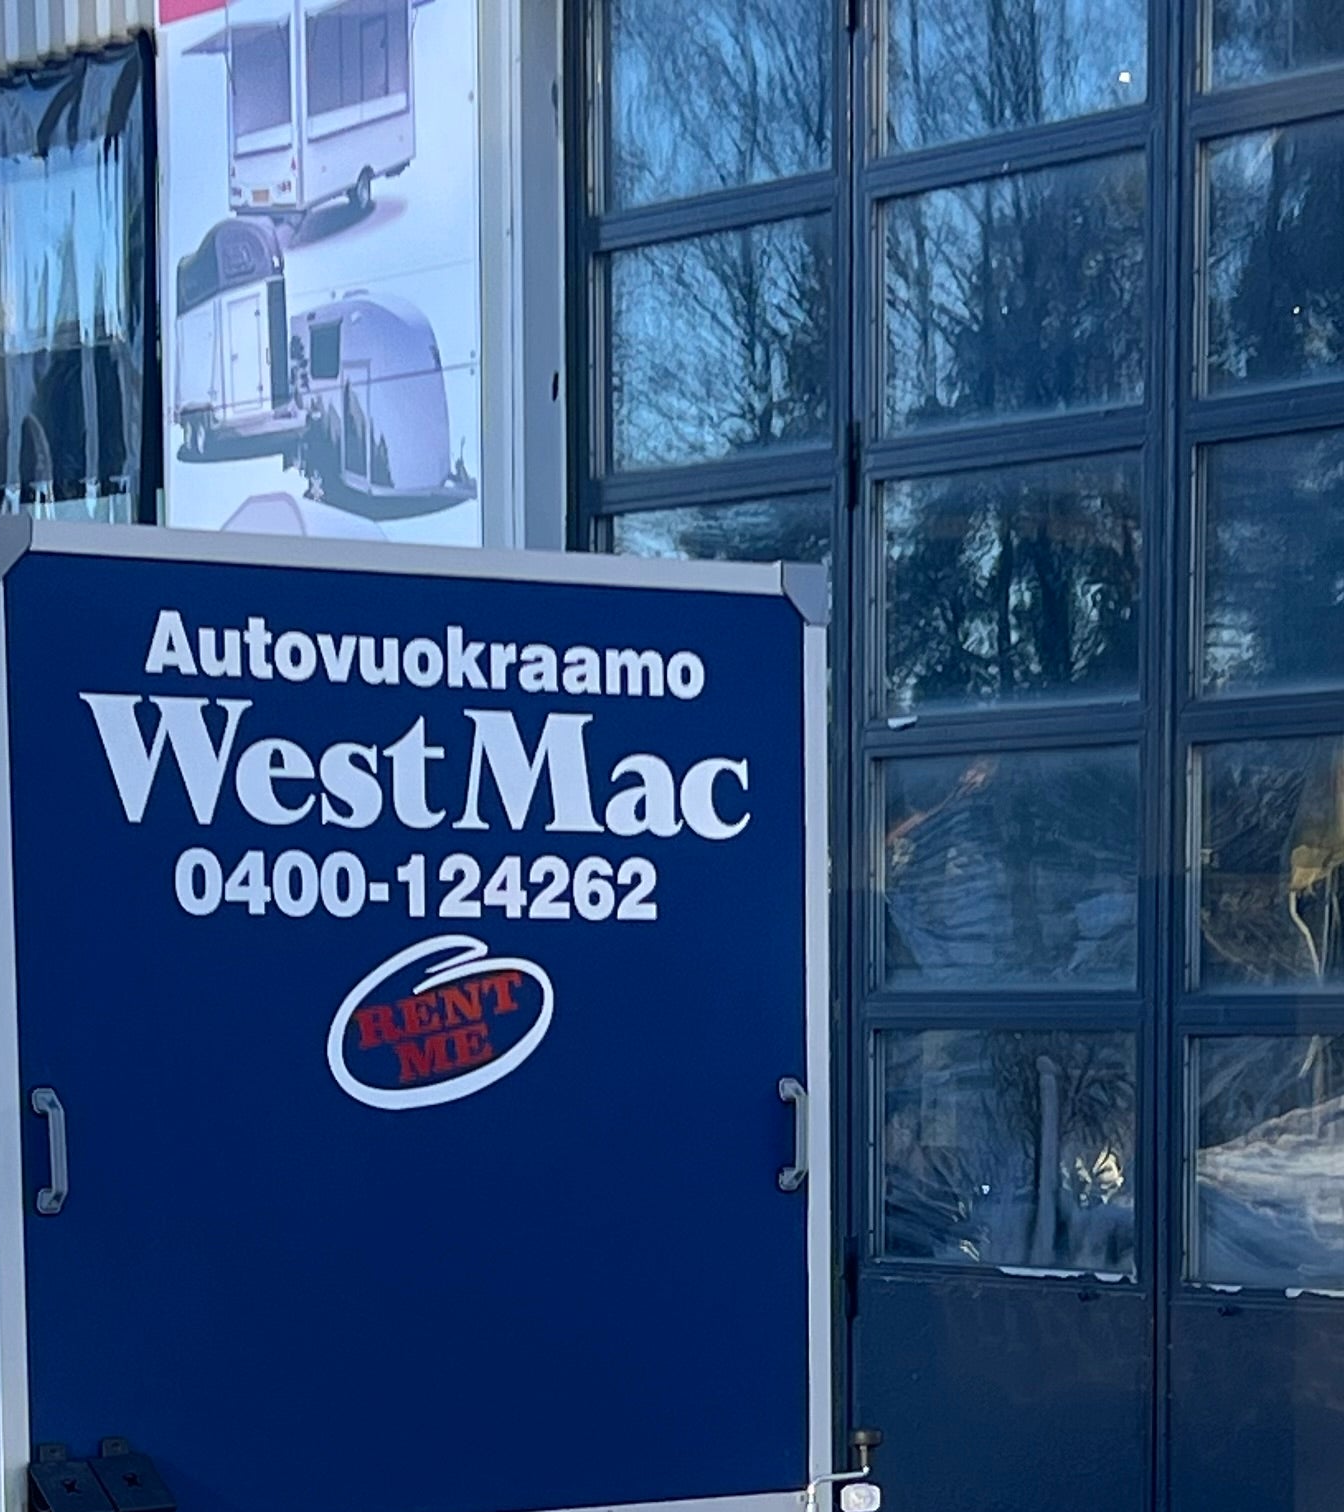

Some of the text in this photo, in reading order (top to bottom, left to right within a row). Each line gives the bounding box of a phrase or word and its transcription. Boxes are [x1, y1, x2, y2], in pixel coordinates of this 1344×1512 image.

[146, 610, 705, 699] Autovuokraamo
[80, 692, 750, 840] WestMac
[175, 848, 657, 921] 0400-124262
[356, 972, 523, 1049] RENT
[395, 1023, 493, 1083] ME
